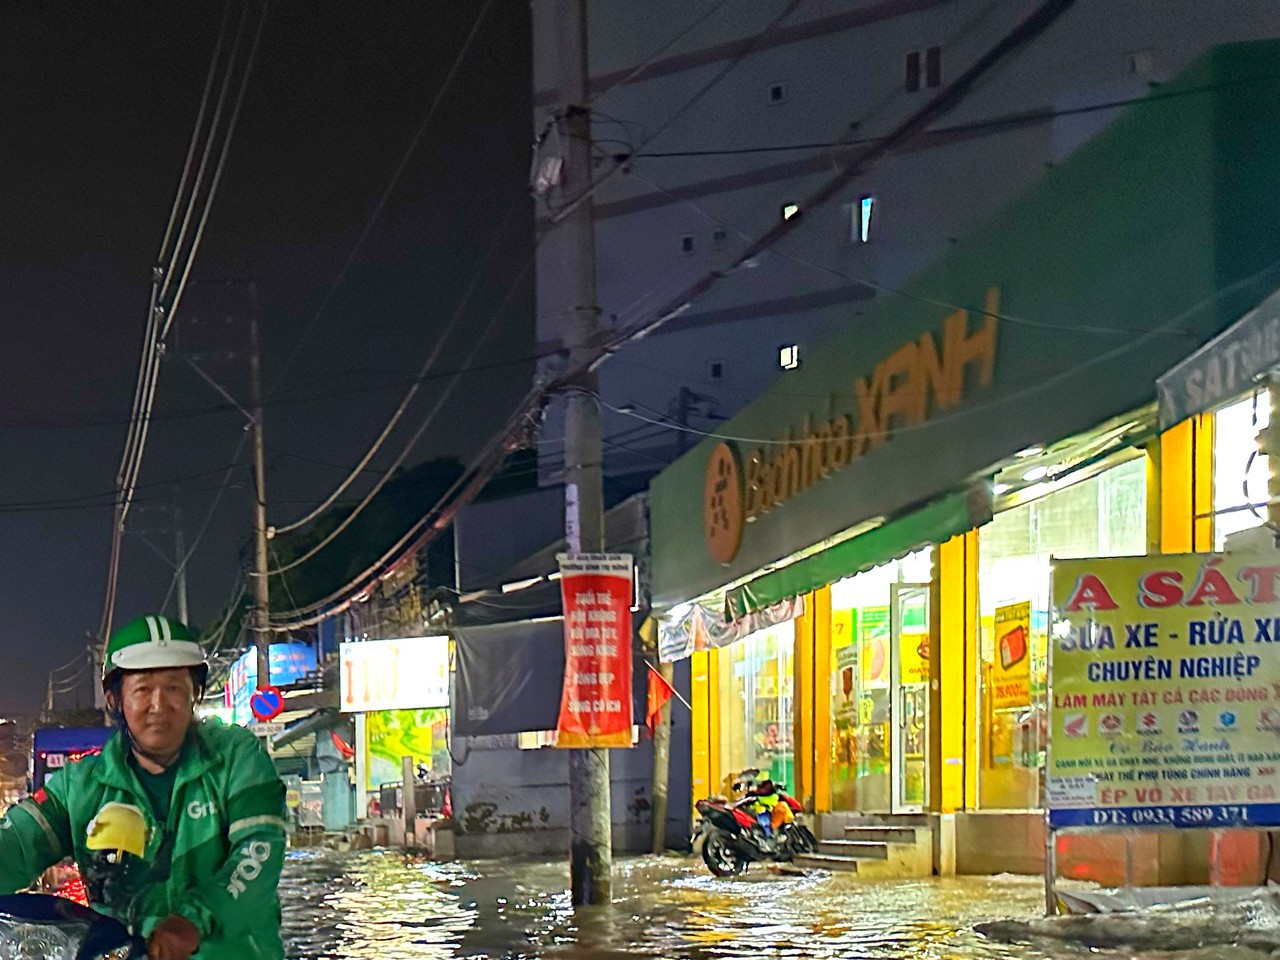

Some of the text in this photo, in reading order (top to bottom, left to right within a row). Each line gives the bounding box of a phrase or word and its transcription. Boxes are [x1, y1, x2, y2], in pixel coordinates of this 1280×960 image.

[854, 286, 1001, 458] XANH
[1062, 557, 1280, 612] A SÁT
[1125, 622, 1159, 649] XE
[1189, 611, 1245, 647] RỬA
[1087, 651, 1261, 682] CHUYÊN NGHIỆP
[1132, 808, 1176, 823] 0933
[1180, 806, 1214, 822] 589
